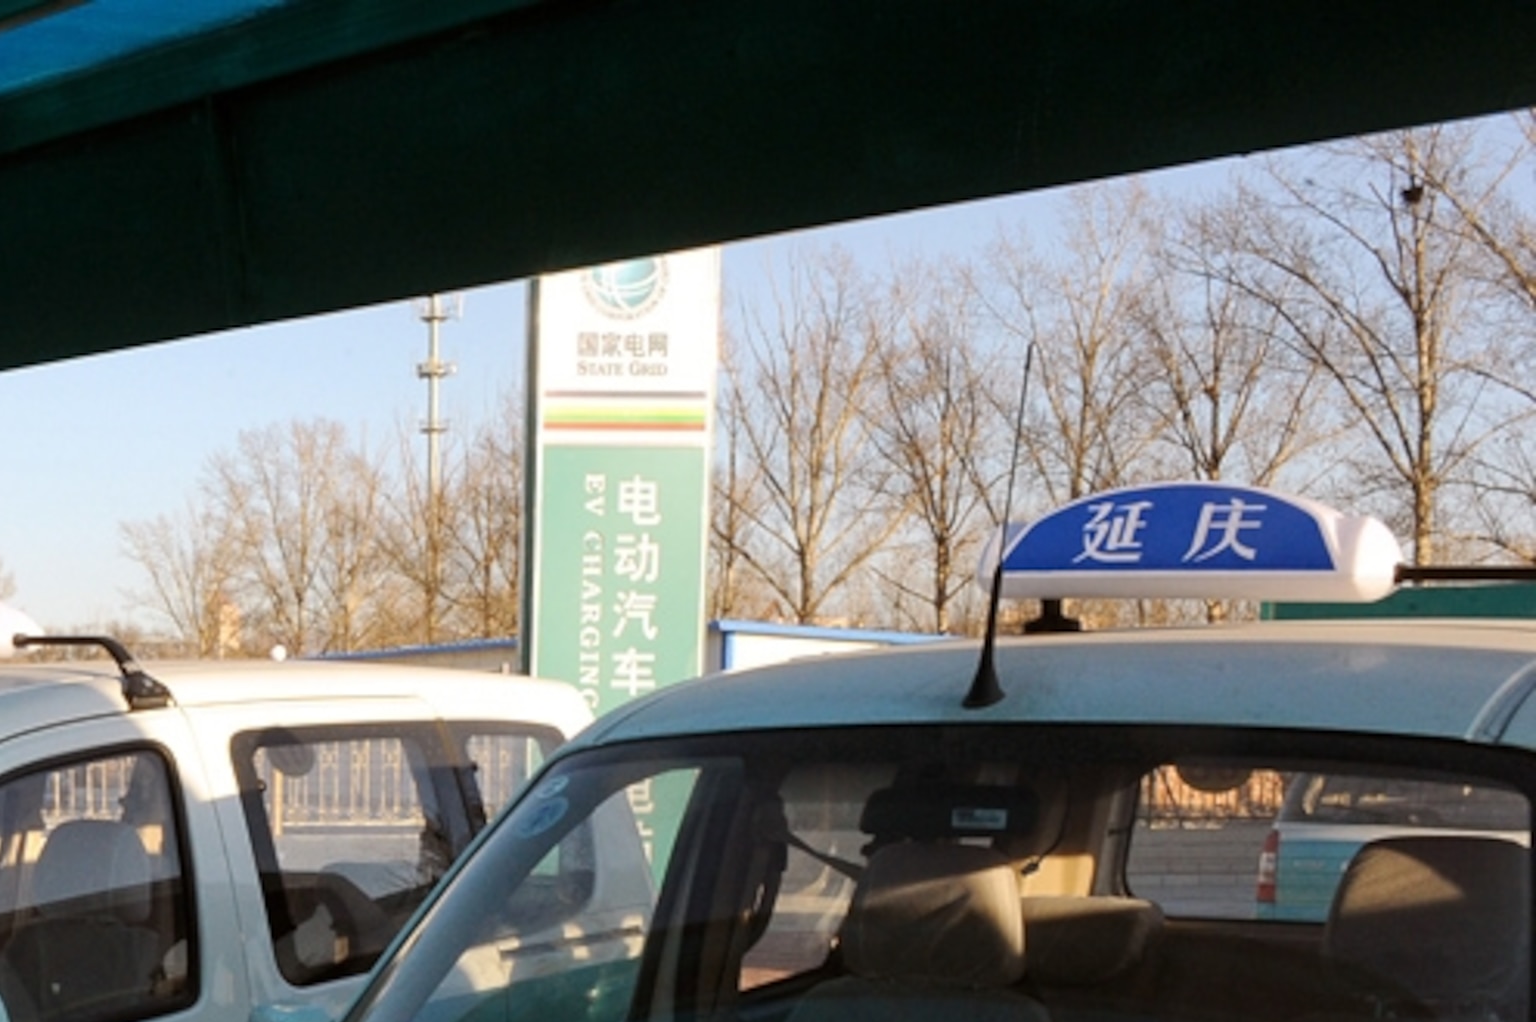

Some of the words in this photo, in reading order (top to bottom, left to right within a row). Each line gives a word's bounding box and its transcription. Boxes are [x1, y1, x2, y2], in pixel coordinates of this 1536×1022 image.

[578, 332, 669, 357] 国家电网
[584, 473, 606, 515] EV
[1073, 498, 1268, 563] 延庆
[611, 474, 660, 697] 电动汽车
